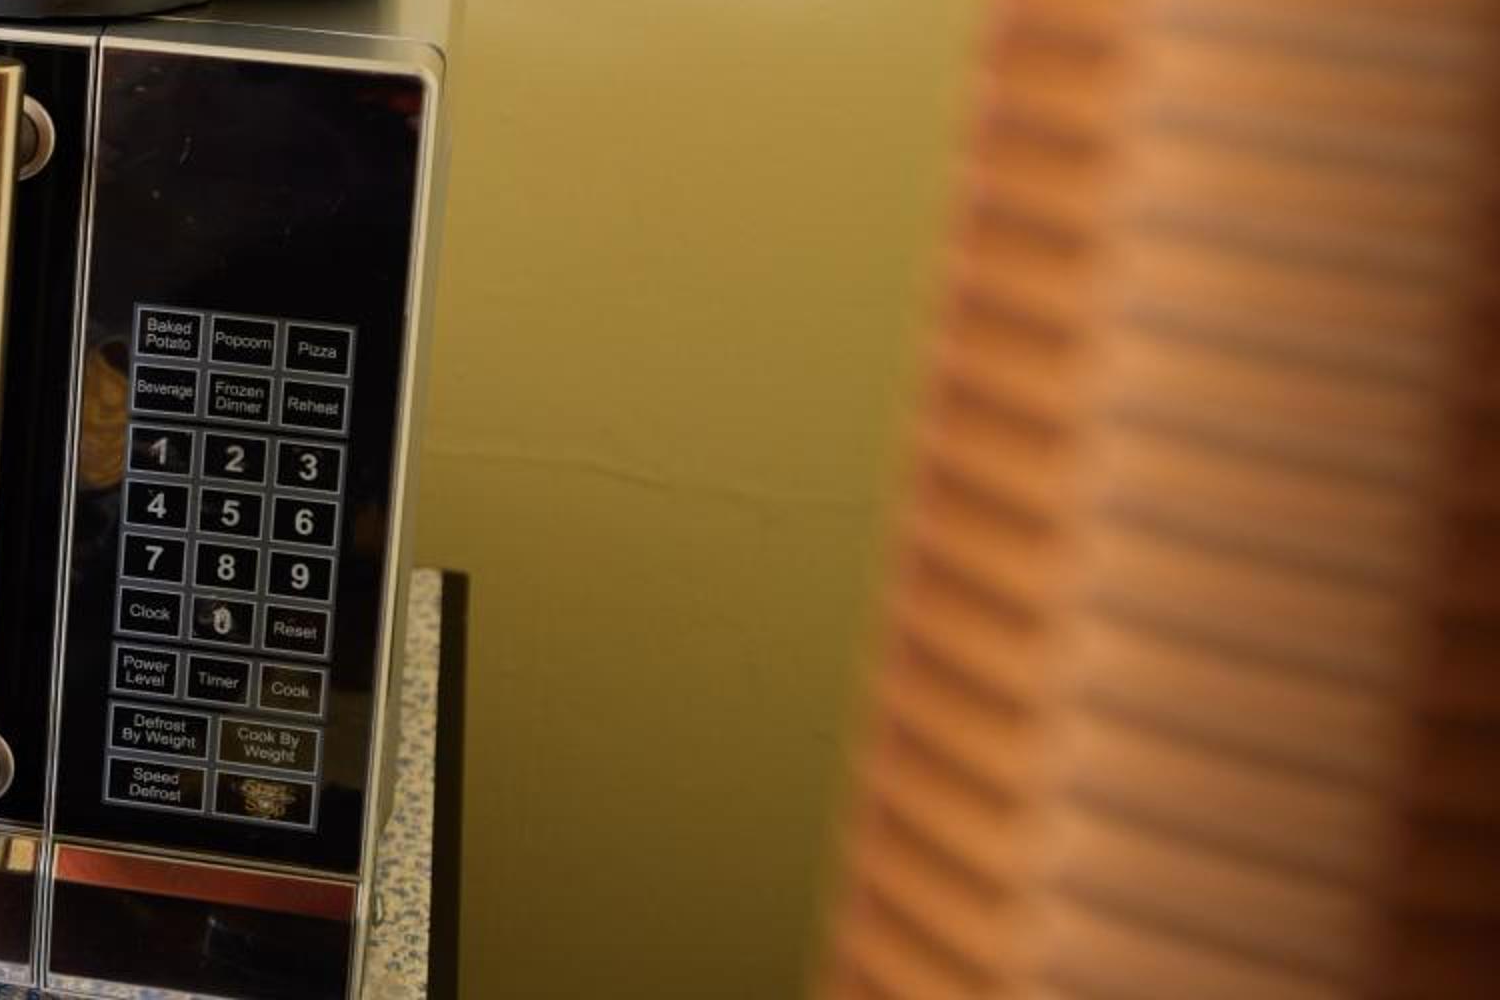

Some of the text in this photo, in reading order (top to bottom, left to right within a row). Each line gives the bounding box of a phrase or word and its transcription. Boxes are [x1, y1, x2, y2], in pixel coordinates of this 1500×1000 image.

[147, 317, 191, 334] Baked
[146, 334, 191, 351] Potato
[214, 331, 271, 350] Popcorn
[298, 341, 337, 359] Pizza
[137, 380, 194, 400] Beverage
[215, 381, 264, 398] Frozen
[215, 398, 262, 415] Dinner
[288, 398, 339, 416] Reheat
[151, 437, 168, 465] 1
[225, 445, 244, 473] 2
[299, 454, 318, 481] 3
[147, 493, 167, 518] 4
[221, 500, 241, 527] 5
[295, 509, 314, 536] 6
[144, 546, 164, 571] 7
[217, 554, 236, 580] 8
[291, 563, 309, 590] 9
[129, 603, 171, 621] Clock
[212, 606, 232, 634] 0
[273, 621, 318, 640] Reset
[123, 655, 170, 673] Power
[125, 671, 164, 687] Level
[199, 671, 239, 689] Timer
[271, 681, 309, 698] Cook
[133, 713, 186, 732] Defrost
[121, 728, 196, 750] By Weight
[237, 727, 300, 748] Cook By
[243, 745, 296, 764] Weight
[133, 768, 180, 785] Speed
[128, 784, 181, 802] Defrost
